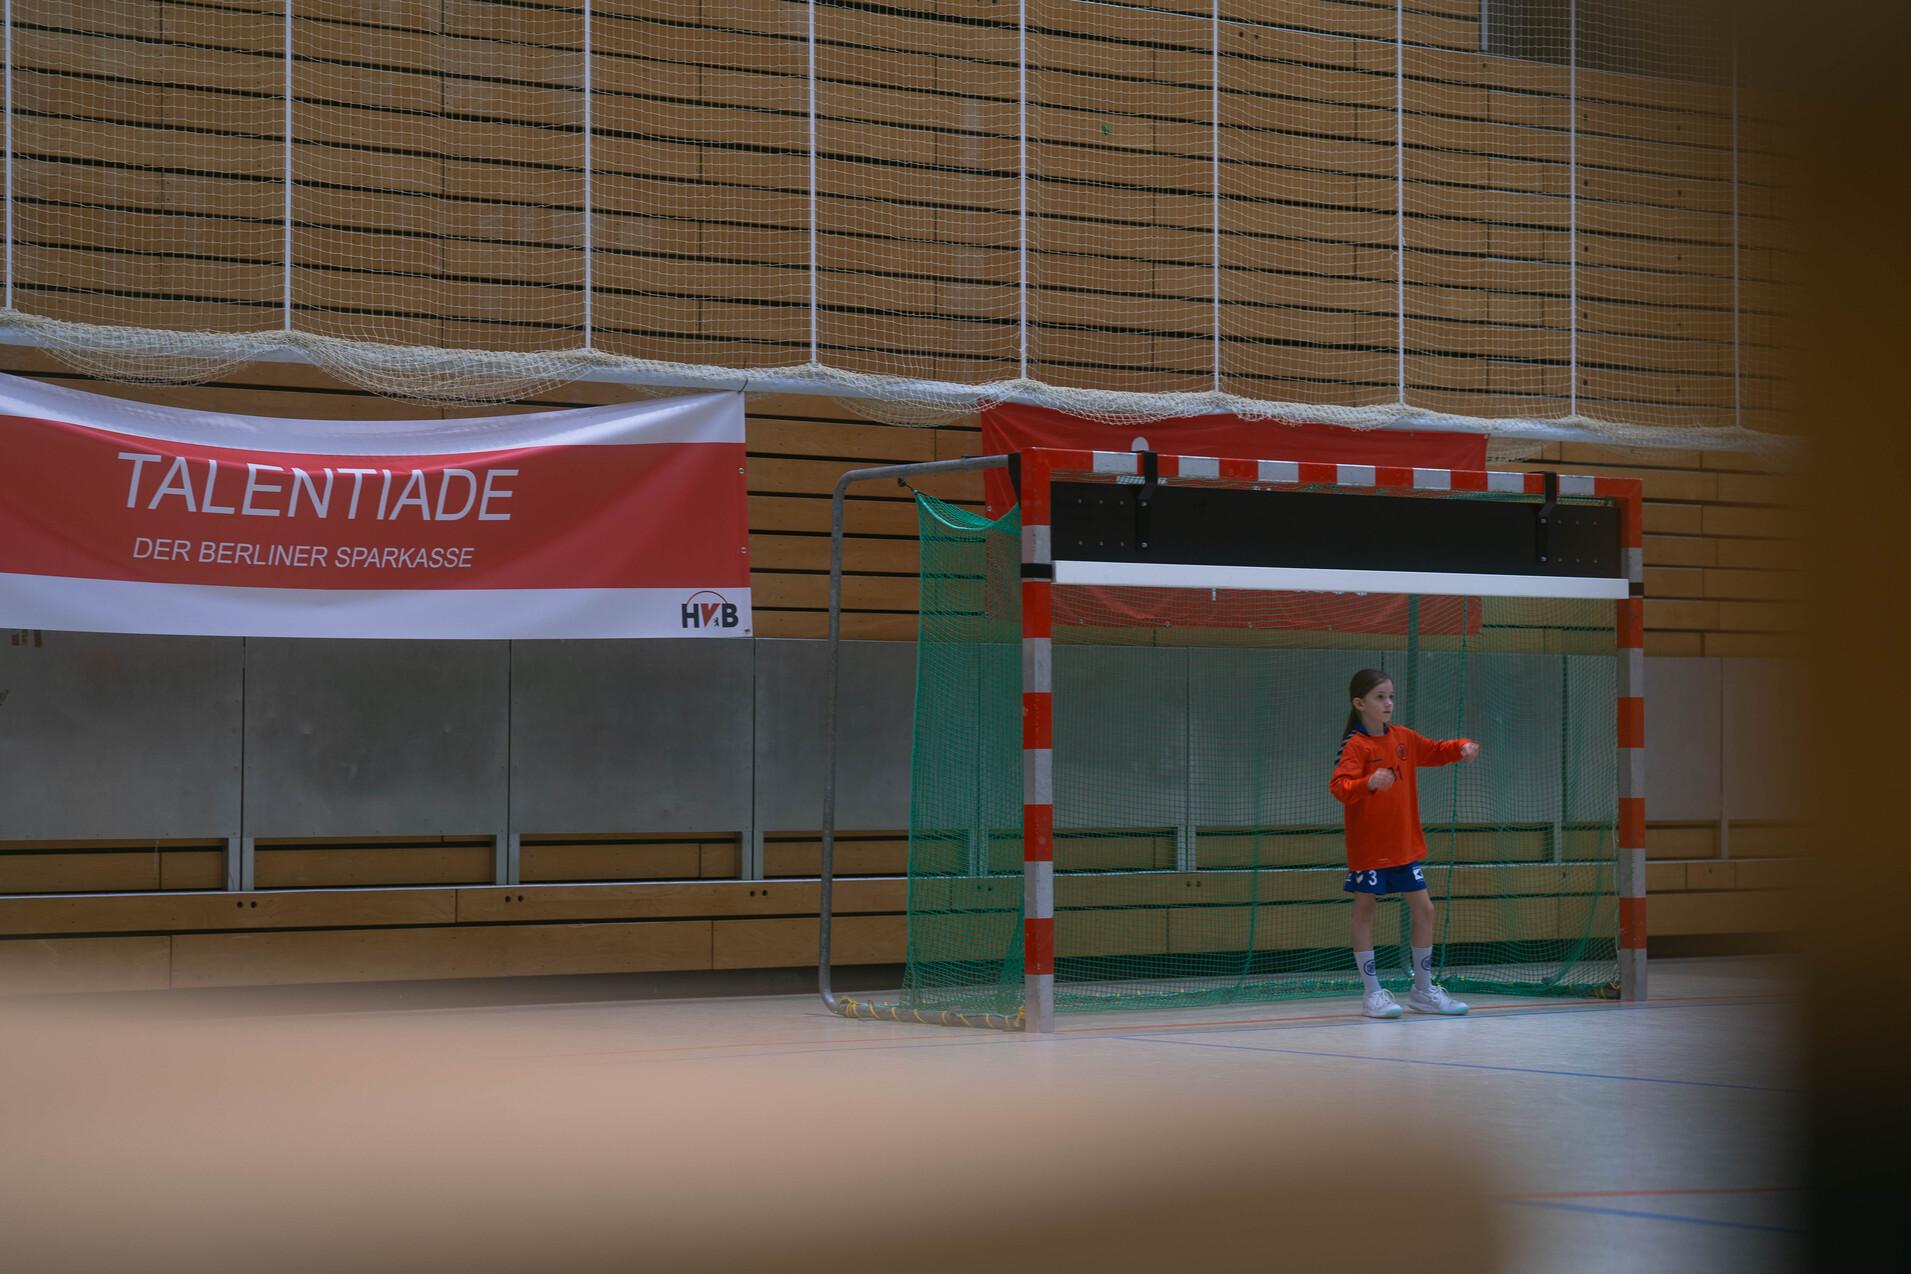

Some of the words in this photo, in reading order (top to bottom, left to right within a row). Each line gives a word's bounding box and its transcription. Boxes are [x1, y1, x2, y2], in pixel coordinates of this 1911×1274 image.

[118, 452, 519, 521] TALENTIADE
[133, 537, 191, 562] DER
[198, 542, 328, 567] BERLINER
[334, 546, 475, 569] SPARKASSE
[681, 602, 739, 628] HVB
